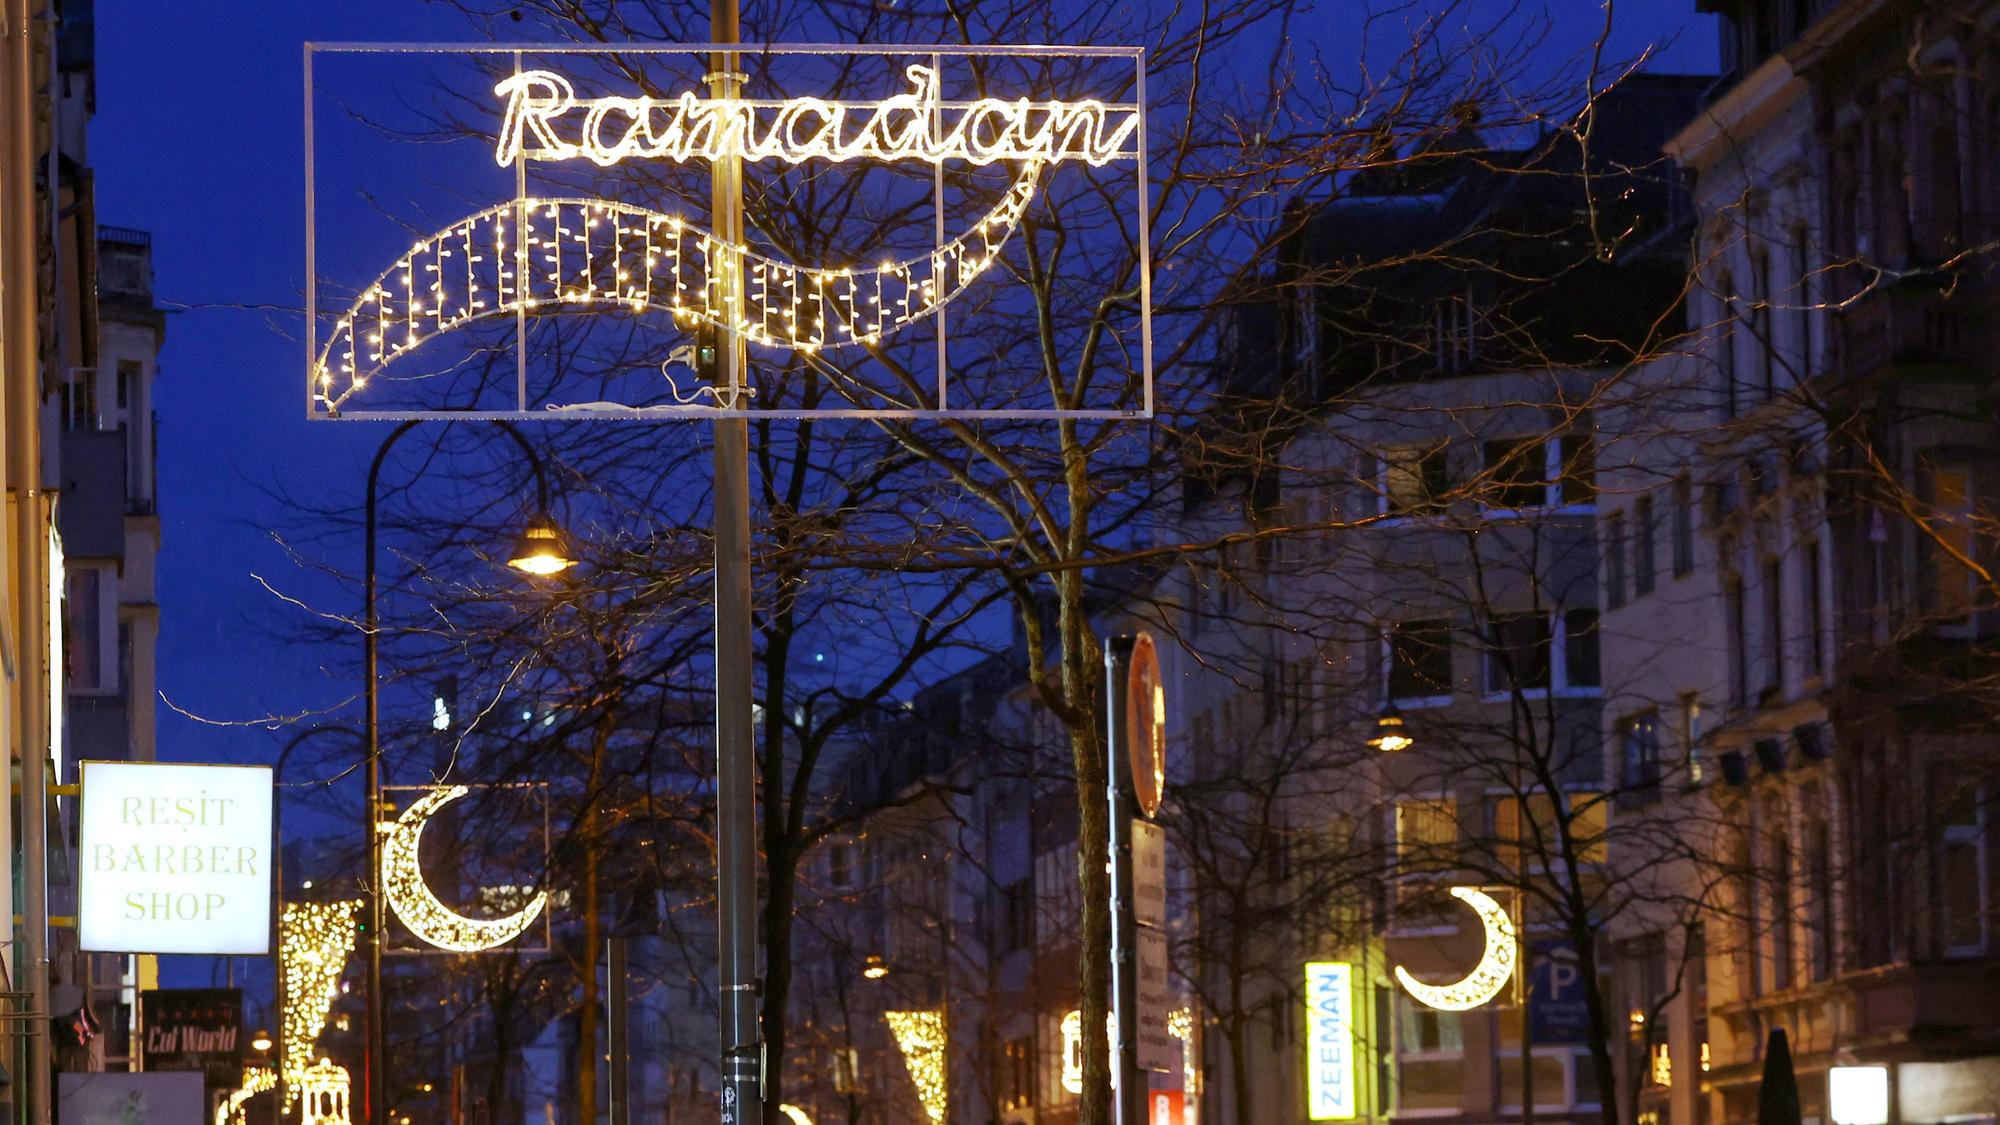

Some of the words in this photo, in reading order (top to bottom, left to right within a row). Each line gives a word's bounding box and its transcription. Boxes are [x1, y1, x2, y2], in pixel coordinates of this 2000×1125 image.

[494, 64, 1139, 167] Ramadan
[92, 843, 258, 876] BARBER
[124, 891, 226, 921] SHOP
[1550, 963, 1577, 1000] P
[147, 1025, 179, 1054] Cut
[181, 1025, 238, 1053] World
[1318, 974, 1342, 1107] ZEEMAN
